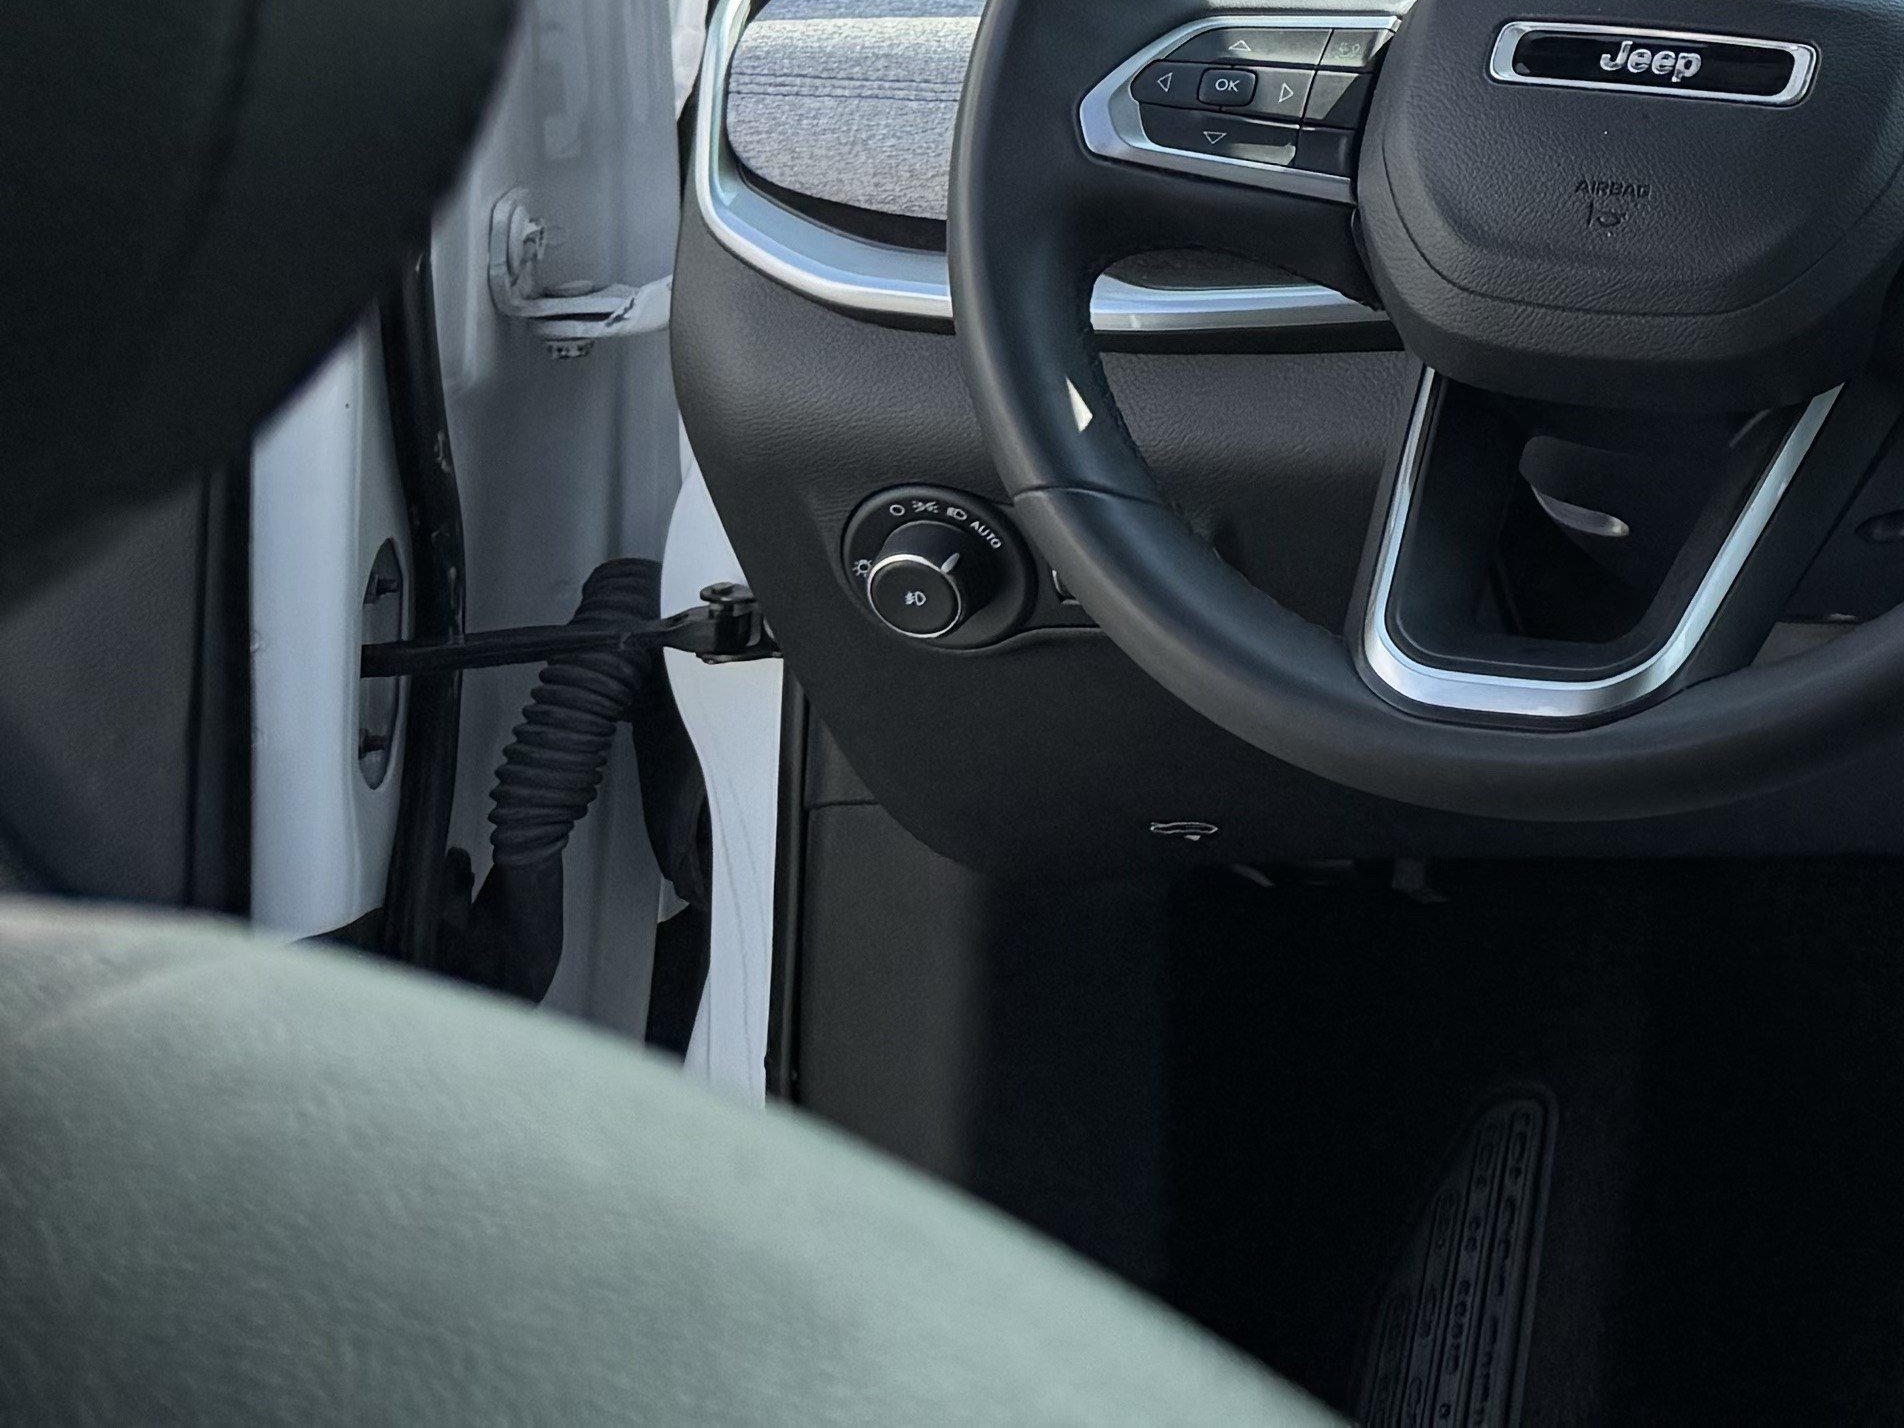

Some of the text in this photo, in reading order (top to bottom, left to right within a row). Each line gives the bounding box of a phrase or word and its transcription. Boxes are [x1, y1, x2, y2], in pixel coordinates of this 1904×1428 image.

[1600, 40, 1702, 82] Jeep
[1214, 78, 1240, 93] OK
[970, 521, 1002, 549] AUTO
